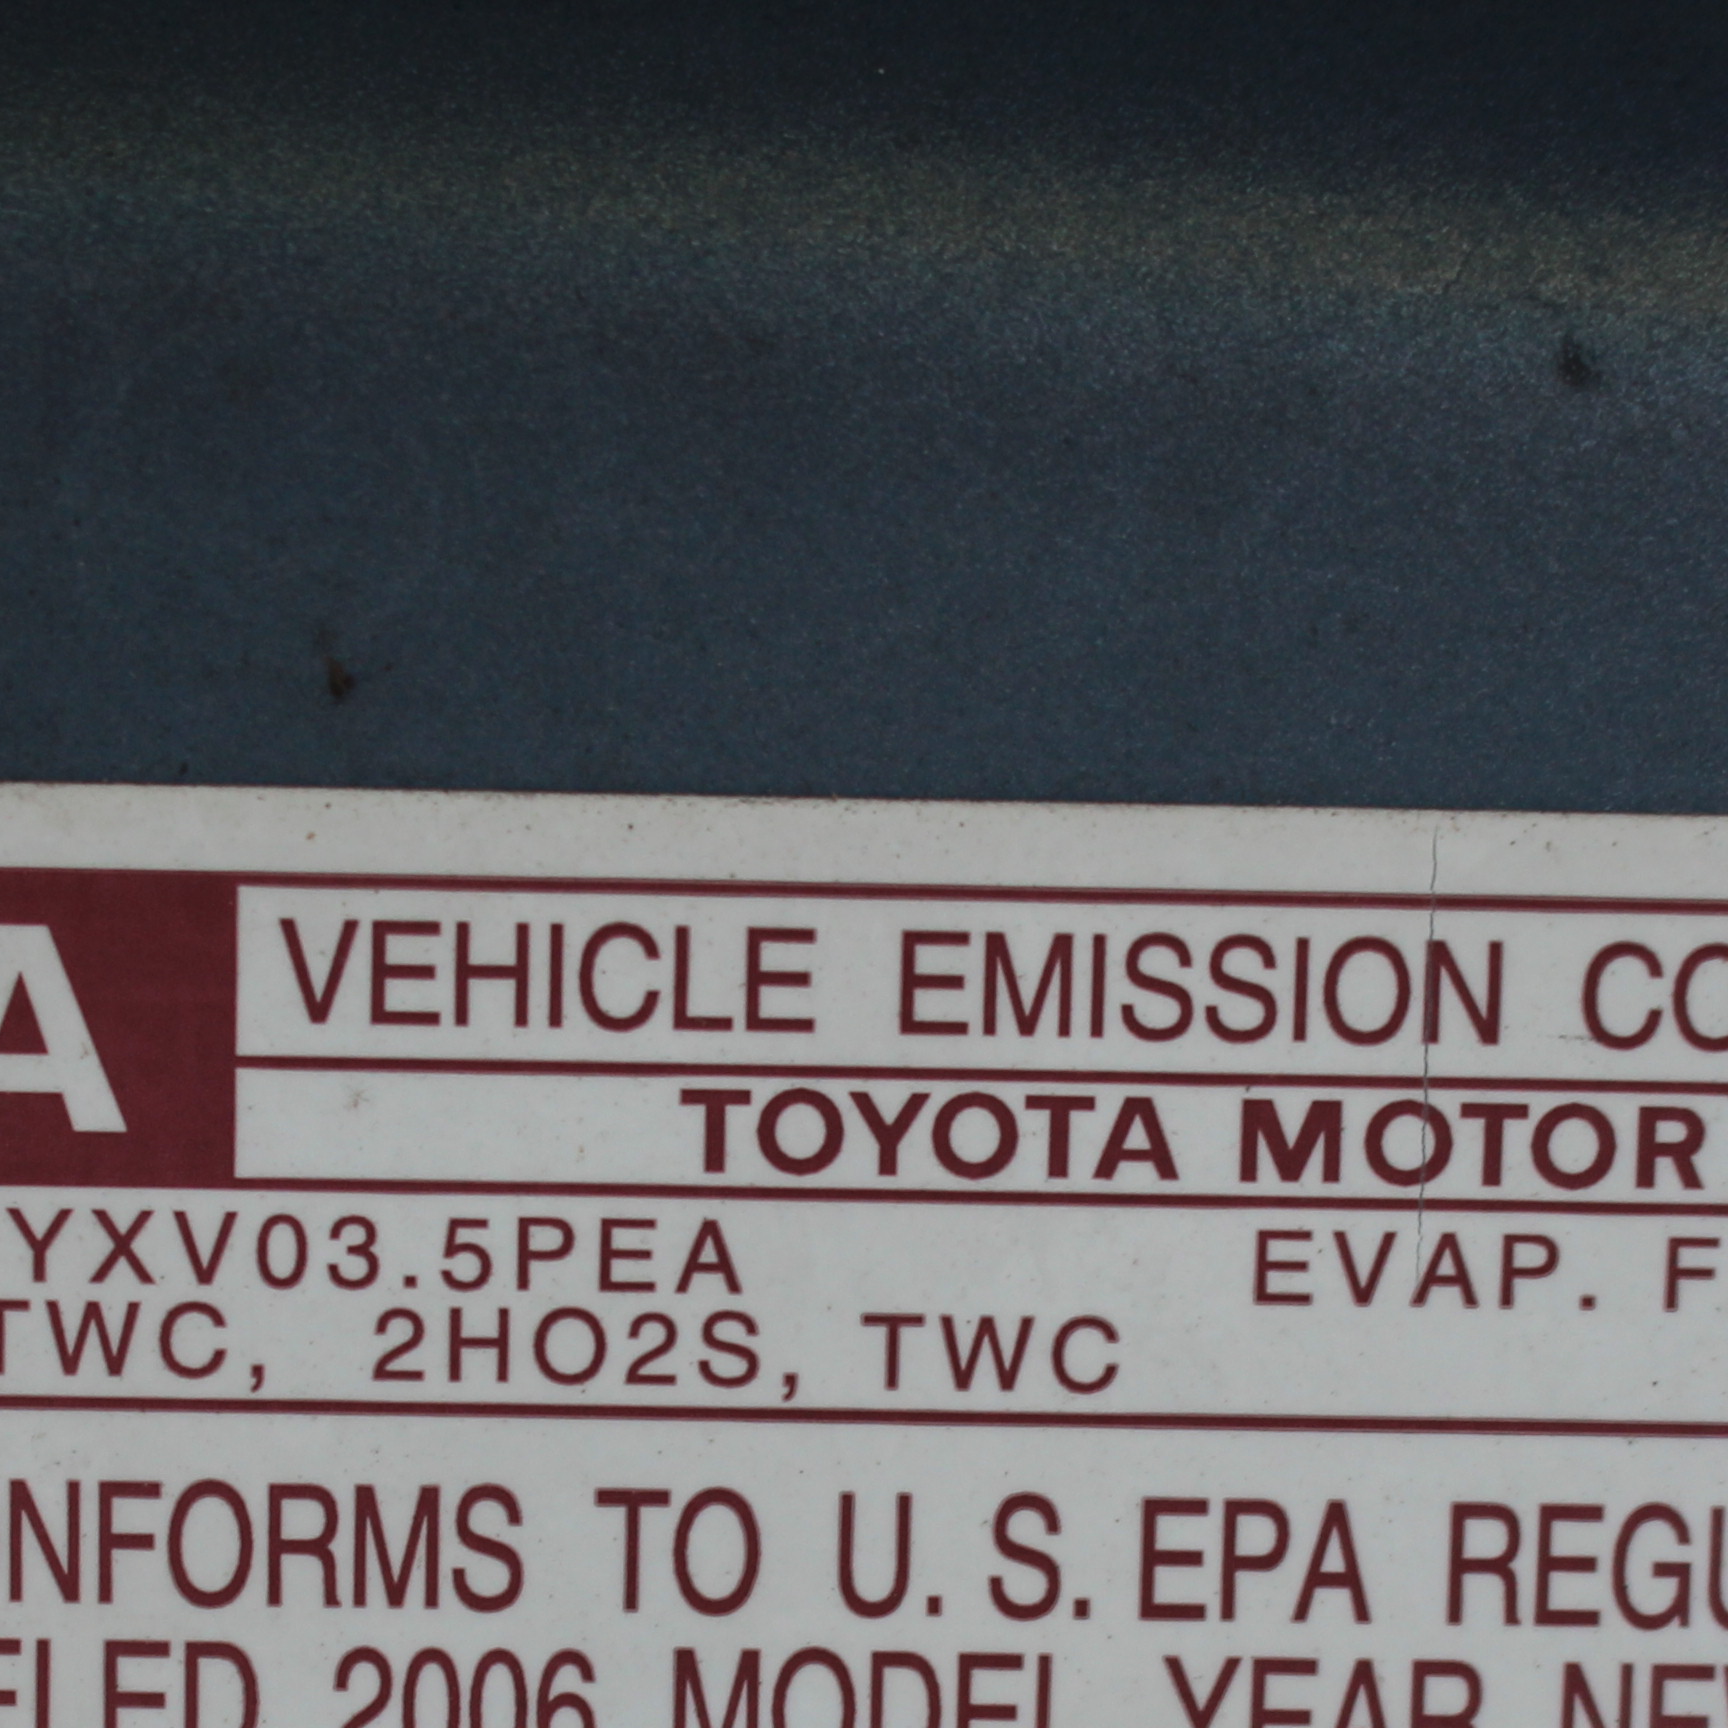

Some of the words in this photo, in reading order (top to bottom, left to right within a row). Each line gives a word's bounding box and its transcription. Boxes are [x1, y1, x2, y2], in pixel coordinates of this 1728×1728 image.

[279, 918, 817, 1033] VEHICLE
[898, 930, 1503, 1055] EMISSION
[679, 1087, 1179, 1181] TOYOTA
[1239, 1098, 1706, 1191] MOTOR
[1253, 1229, 1596, 1310] EVAP.
[372, 1307, 798, 1402] 2HO2S,
[861, 1313, 1119, 1394] TWC
[594, 1487, 762, 1617] TO
[1139, 1497, 1371, 1624] EPA
